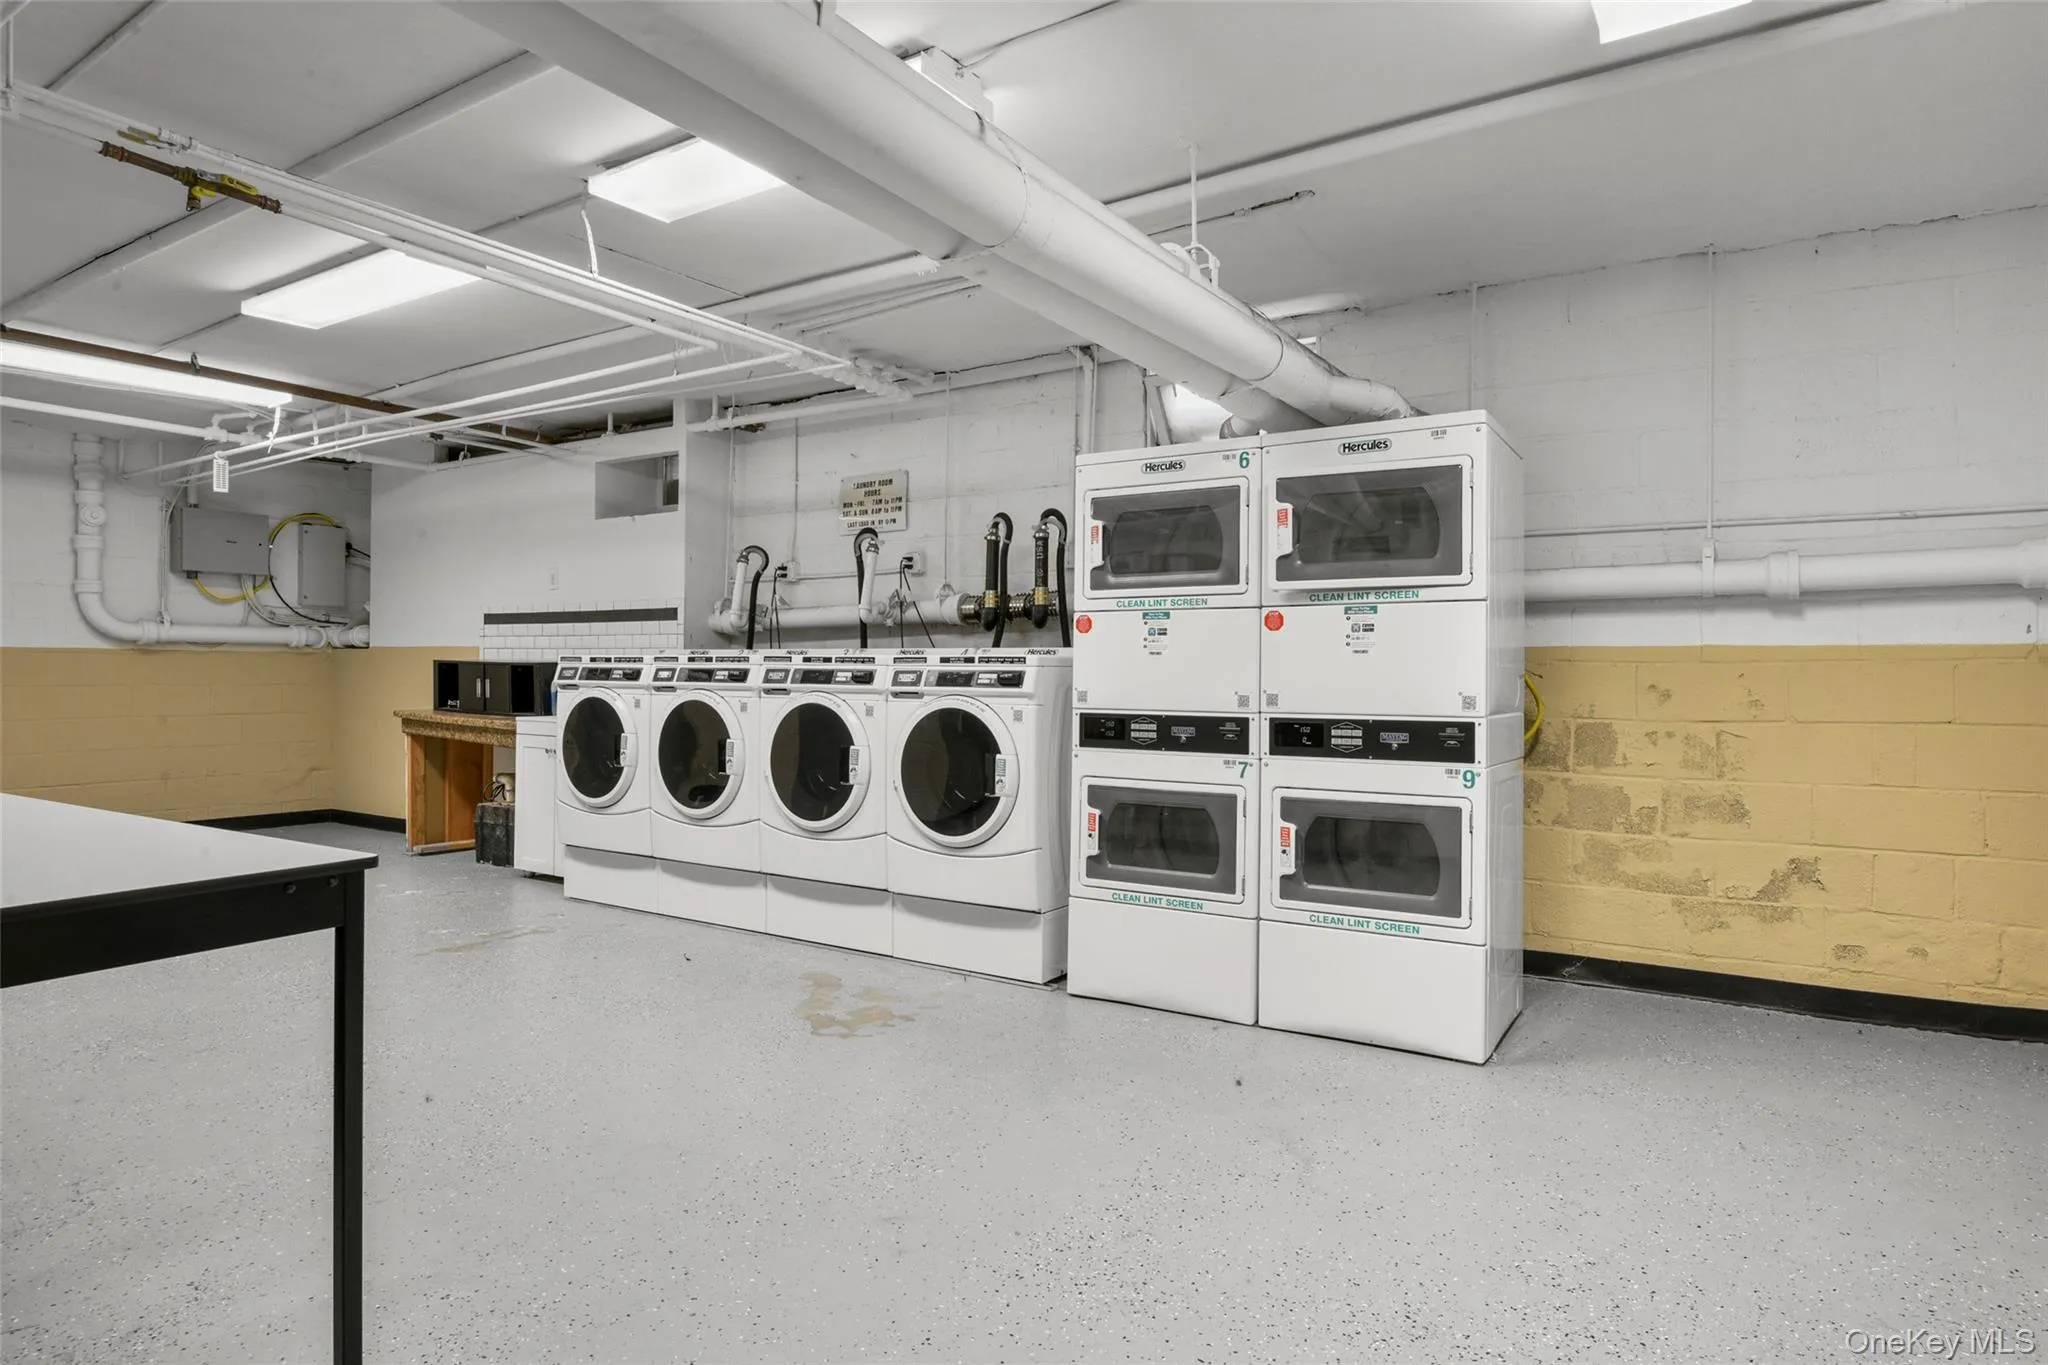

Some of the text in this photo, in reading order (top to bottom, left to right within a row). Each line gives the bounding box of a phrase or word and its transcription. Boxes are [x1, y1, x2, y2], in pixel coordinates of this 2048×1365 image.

[1342, 439, 1389, 453] Hercules
[1144, 461, 1184, 473] Hercules
[1238, 451, 1250, 469] 6
[877, 478, 893, 487] ROOM
[863, 489, 881, 497] HOURS
[1116, 598, 1208, 608] CLEAN LINT SCREEN
[1309, 590, 1420, 602] CLEAN LINT SCREEN
[1237, 761, 1249, 778] 7
[1462, 769, 1476, 789] 9
[1112, 892, 1203, 910] CLEAN LINT SCREEN
[1309, 914, 1420, 934] CLEAN LINT SCREEN
